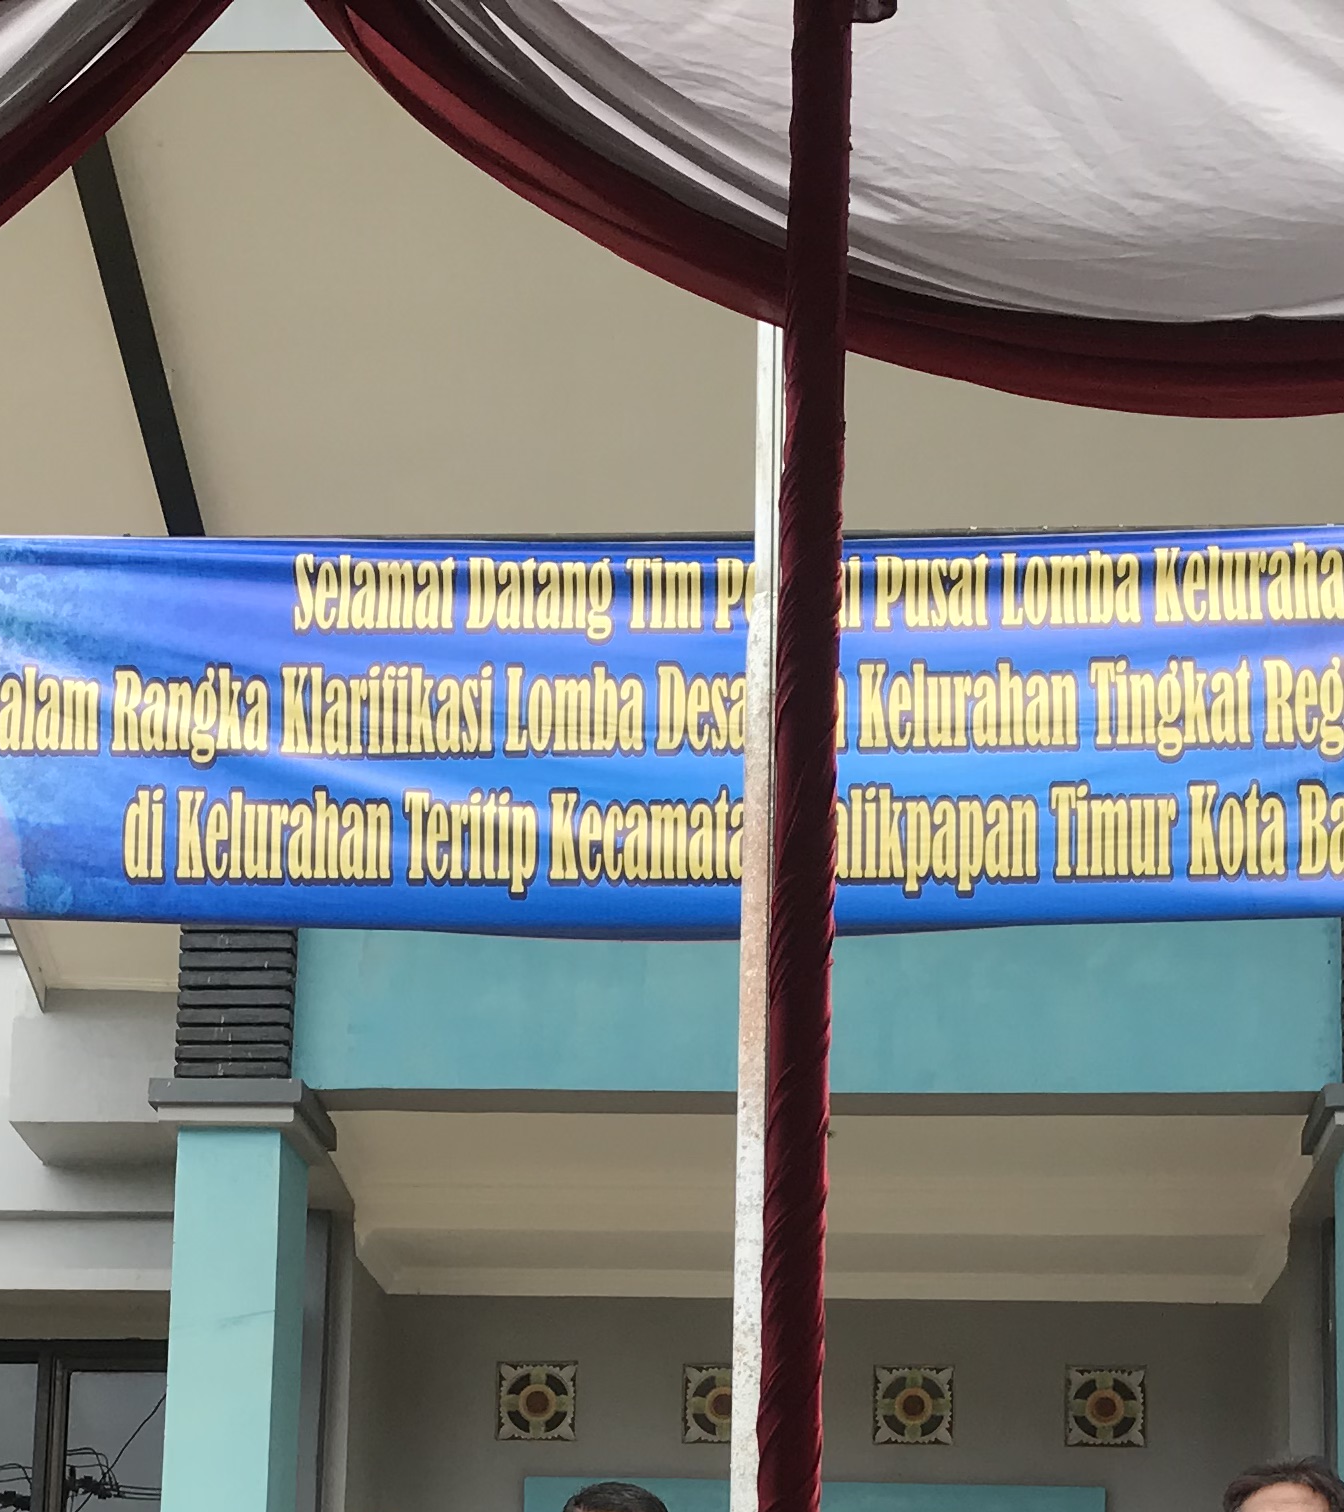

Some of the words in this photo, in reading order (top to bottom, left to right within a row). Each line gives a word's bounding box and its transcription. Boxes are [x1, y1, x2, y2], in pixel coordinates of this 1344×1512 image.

[293, 554, 455, 631] Selamat
[465, 557, 614, 642] Datang
[626, 557, 702, 631] Tim
[874, 553, 989, 629] Pusat
[1001, 549, 1142, 628] Lomba
[111, 666, 269, 764] Rangka
[280, 664, 493, 756] Klarifikasi
[504, 665, 644, 753] Lomba
[656, 664, 746, 754] Desa
[858, 661, 1078, 749] Kelurahan
[1089, 659, 1252, 758] Tingkat
[123, 788, 164, 879] di
[175, 789, 392, 881] Kelurahan
[404, 790, 538, 895] Teritip
[548, 790, 744, 882] Kecamata
[836, 785, 1038, 893] alikpapan
[1050, 783, 1178, 878] Timur
[1188, 783, 1287, 877] Kota
